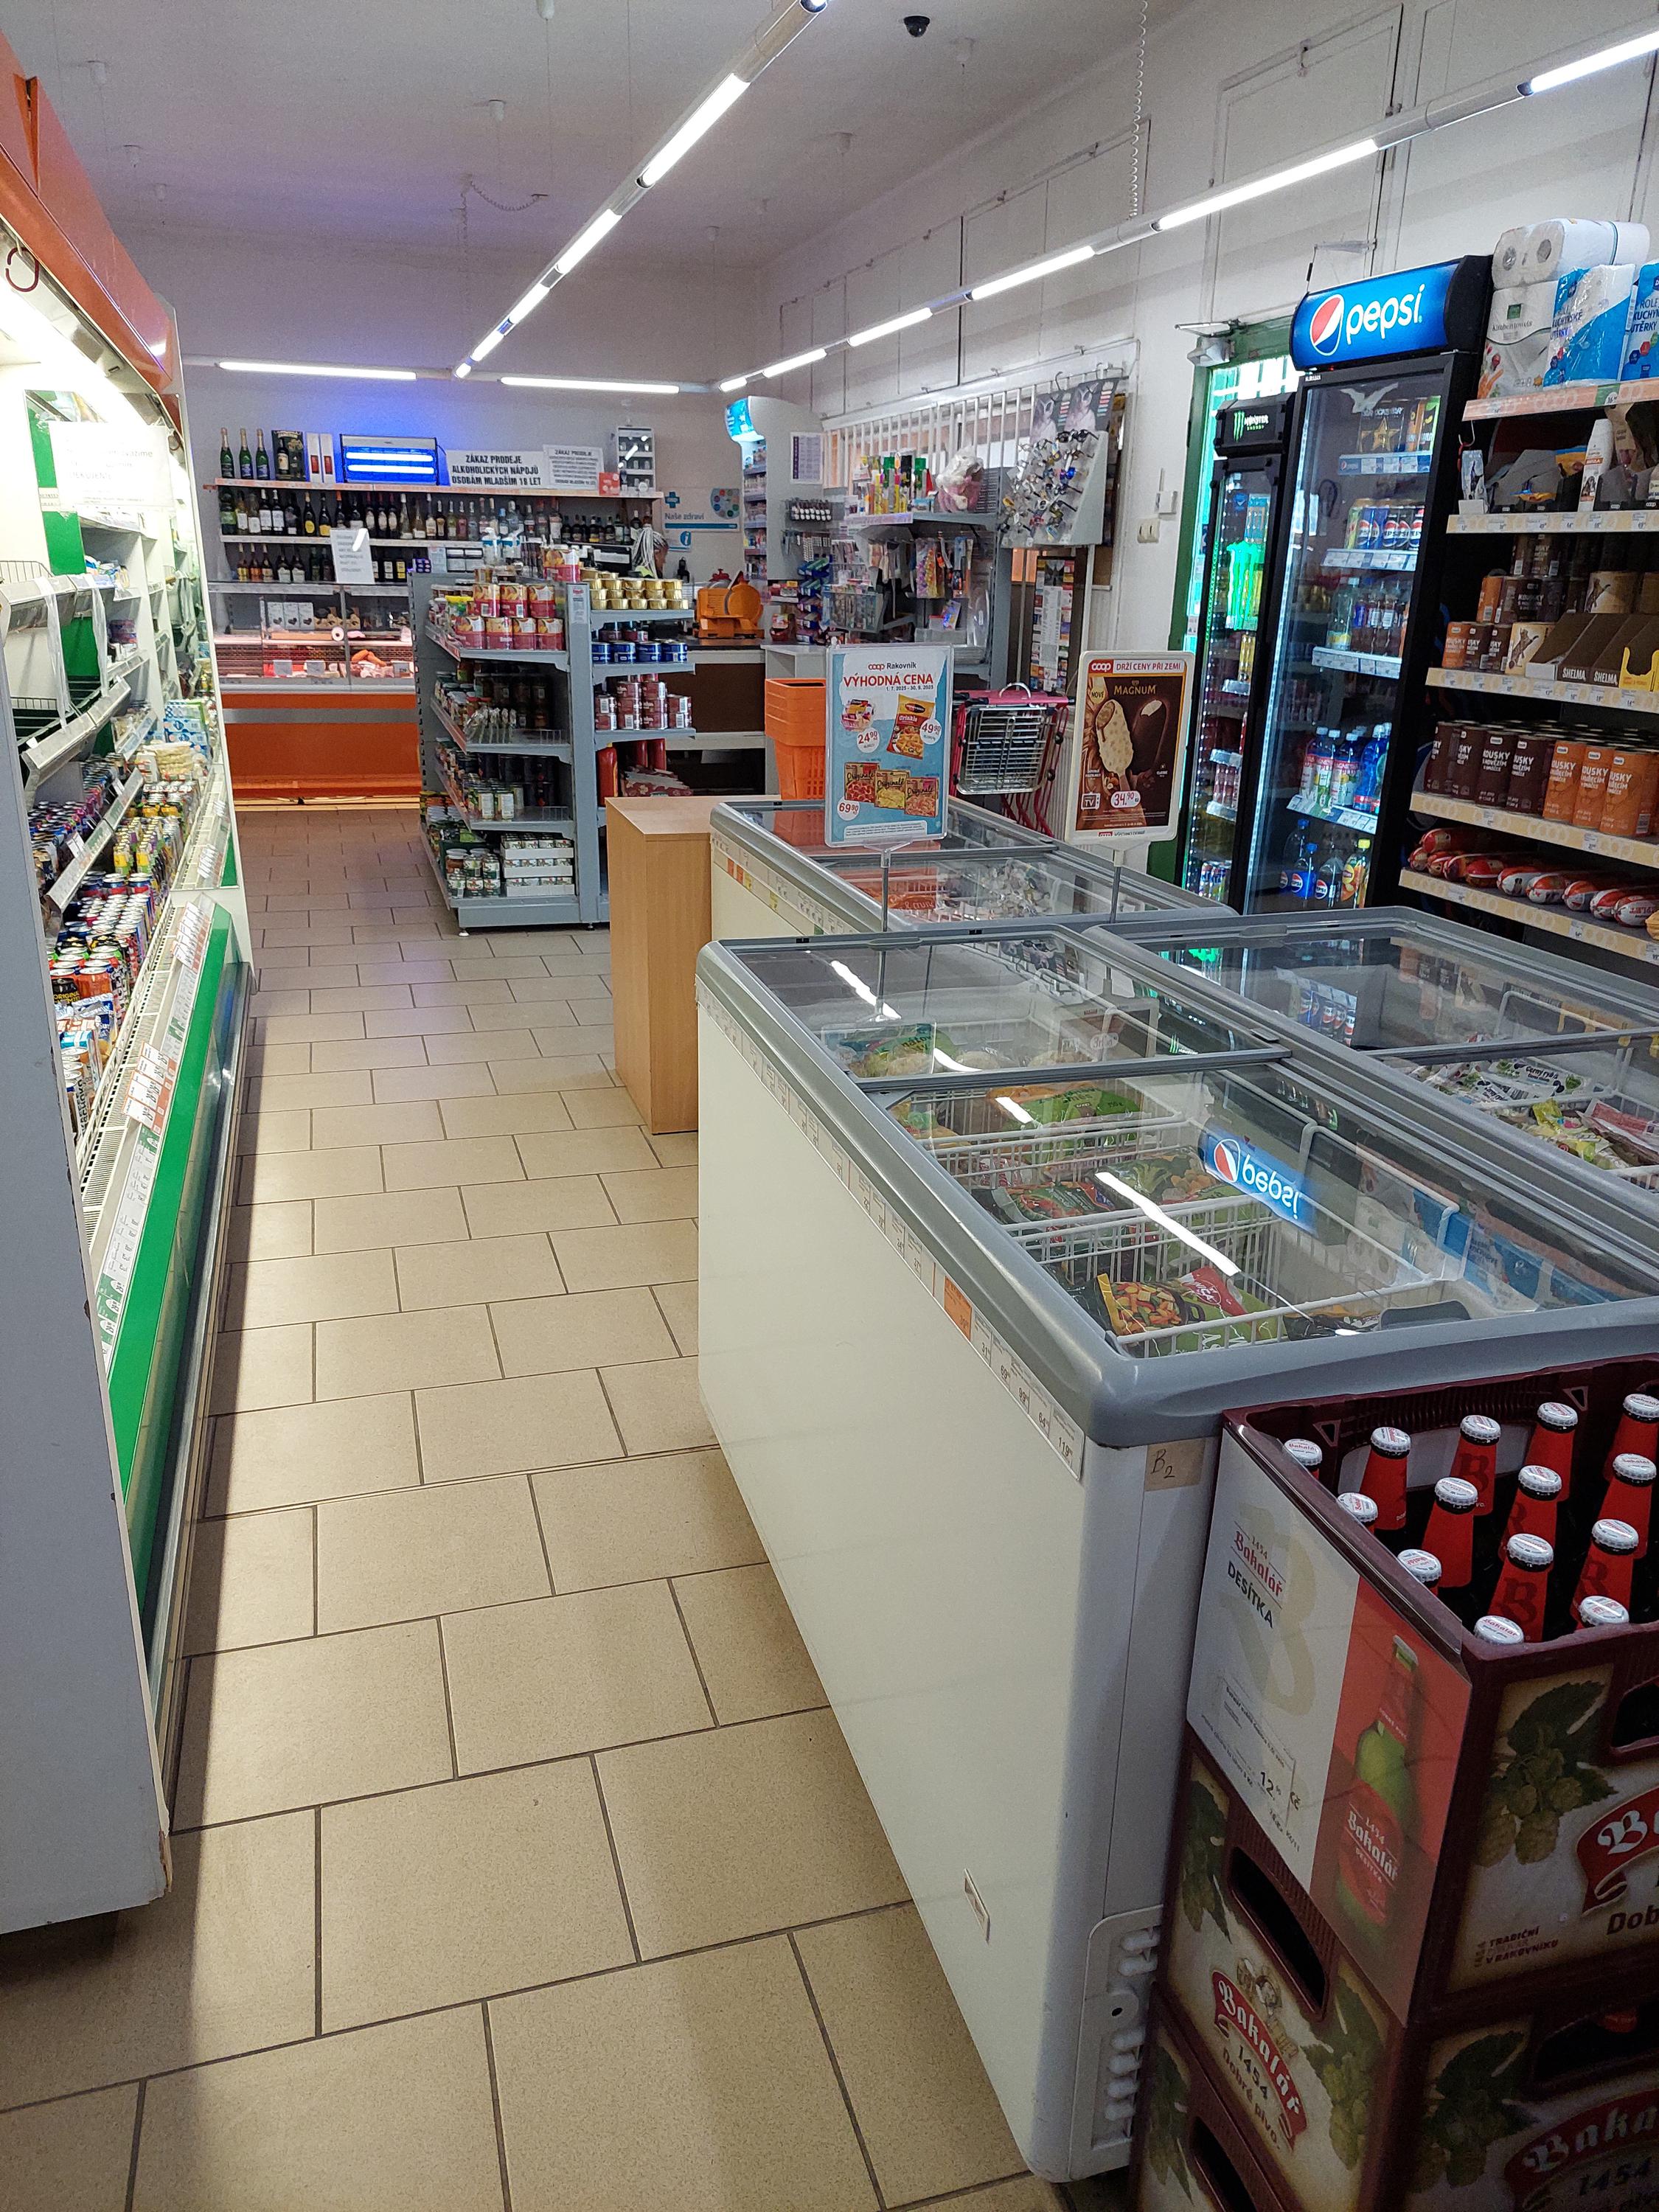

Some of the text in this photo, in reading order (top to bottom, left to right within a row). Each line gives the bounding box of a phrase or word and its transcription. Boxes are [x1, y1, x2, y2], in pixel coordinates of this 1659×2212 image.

[1346, 284, 1425, 345] pepsi
[465, 453, 523, 464] ZÁKAZ PRODEJE
[452, 465, 539, 475] ALKOHOLICKÝCH NÁPOJŮ
[451, 475, 541, 486] OSOBÁM MLADŠÍM 18 LET
[886, 661, 917, 669] Rakovník
[1091, 663, 1111, 672] coop
[1116, 662, 1132, 671] DRŽÍ
[1152, 662, 1163, 670] PŘI
[843, 671, 934, 687] VÝHODNÁ CENA
[1562, 667, 1586, 681] SHELMA
[1593, 671, 1618, 686] SHELMA
[1114, 685, 1156, 695] MAGNUM
[1234, 1530, 1284, 1599] Bakalář
[1227, 1560, 1274, 1630] DESÍTKA
[1348, 1809, 1399, 1882] Bakalář
[1217, 1979, 1304, 2115] Bakalář
[1237, 2044, 1269, 2101] 1454
